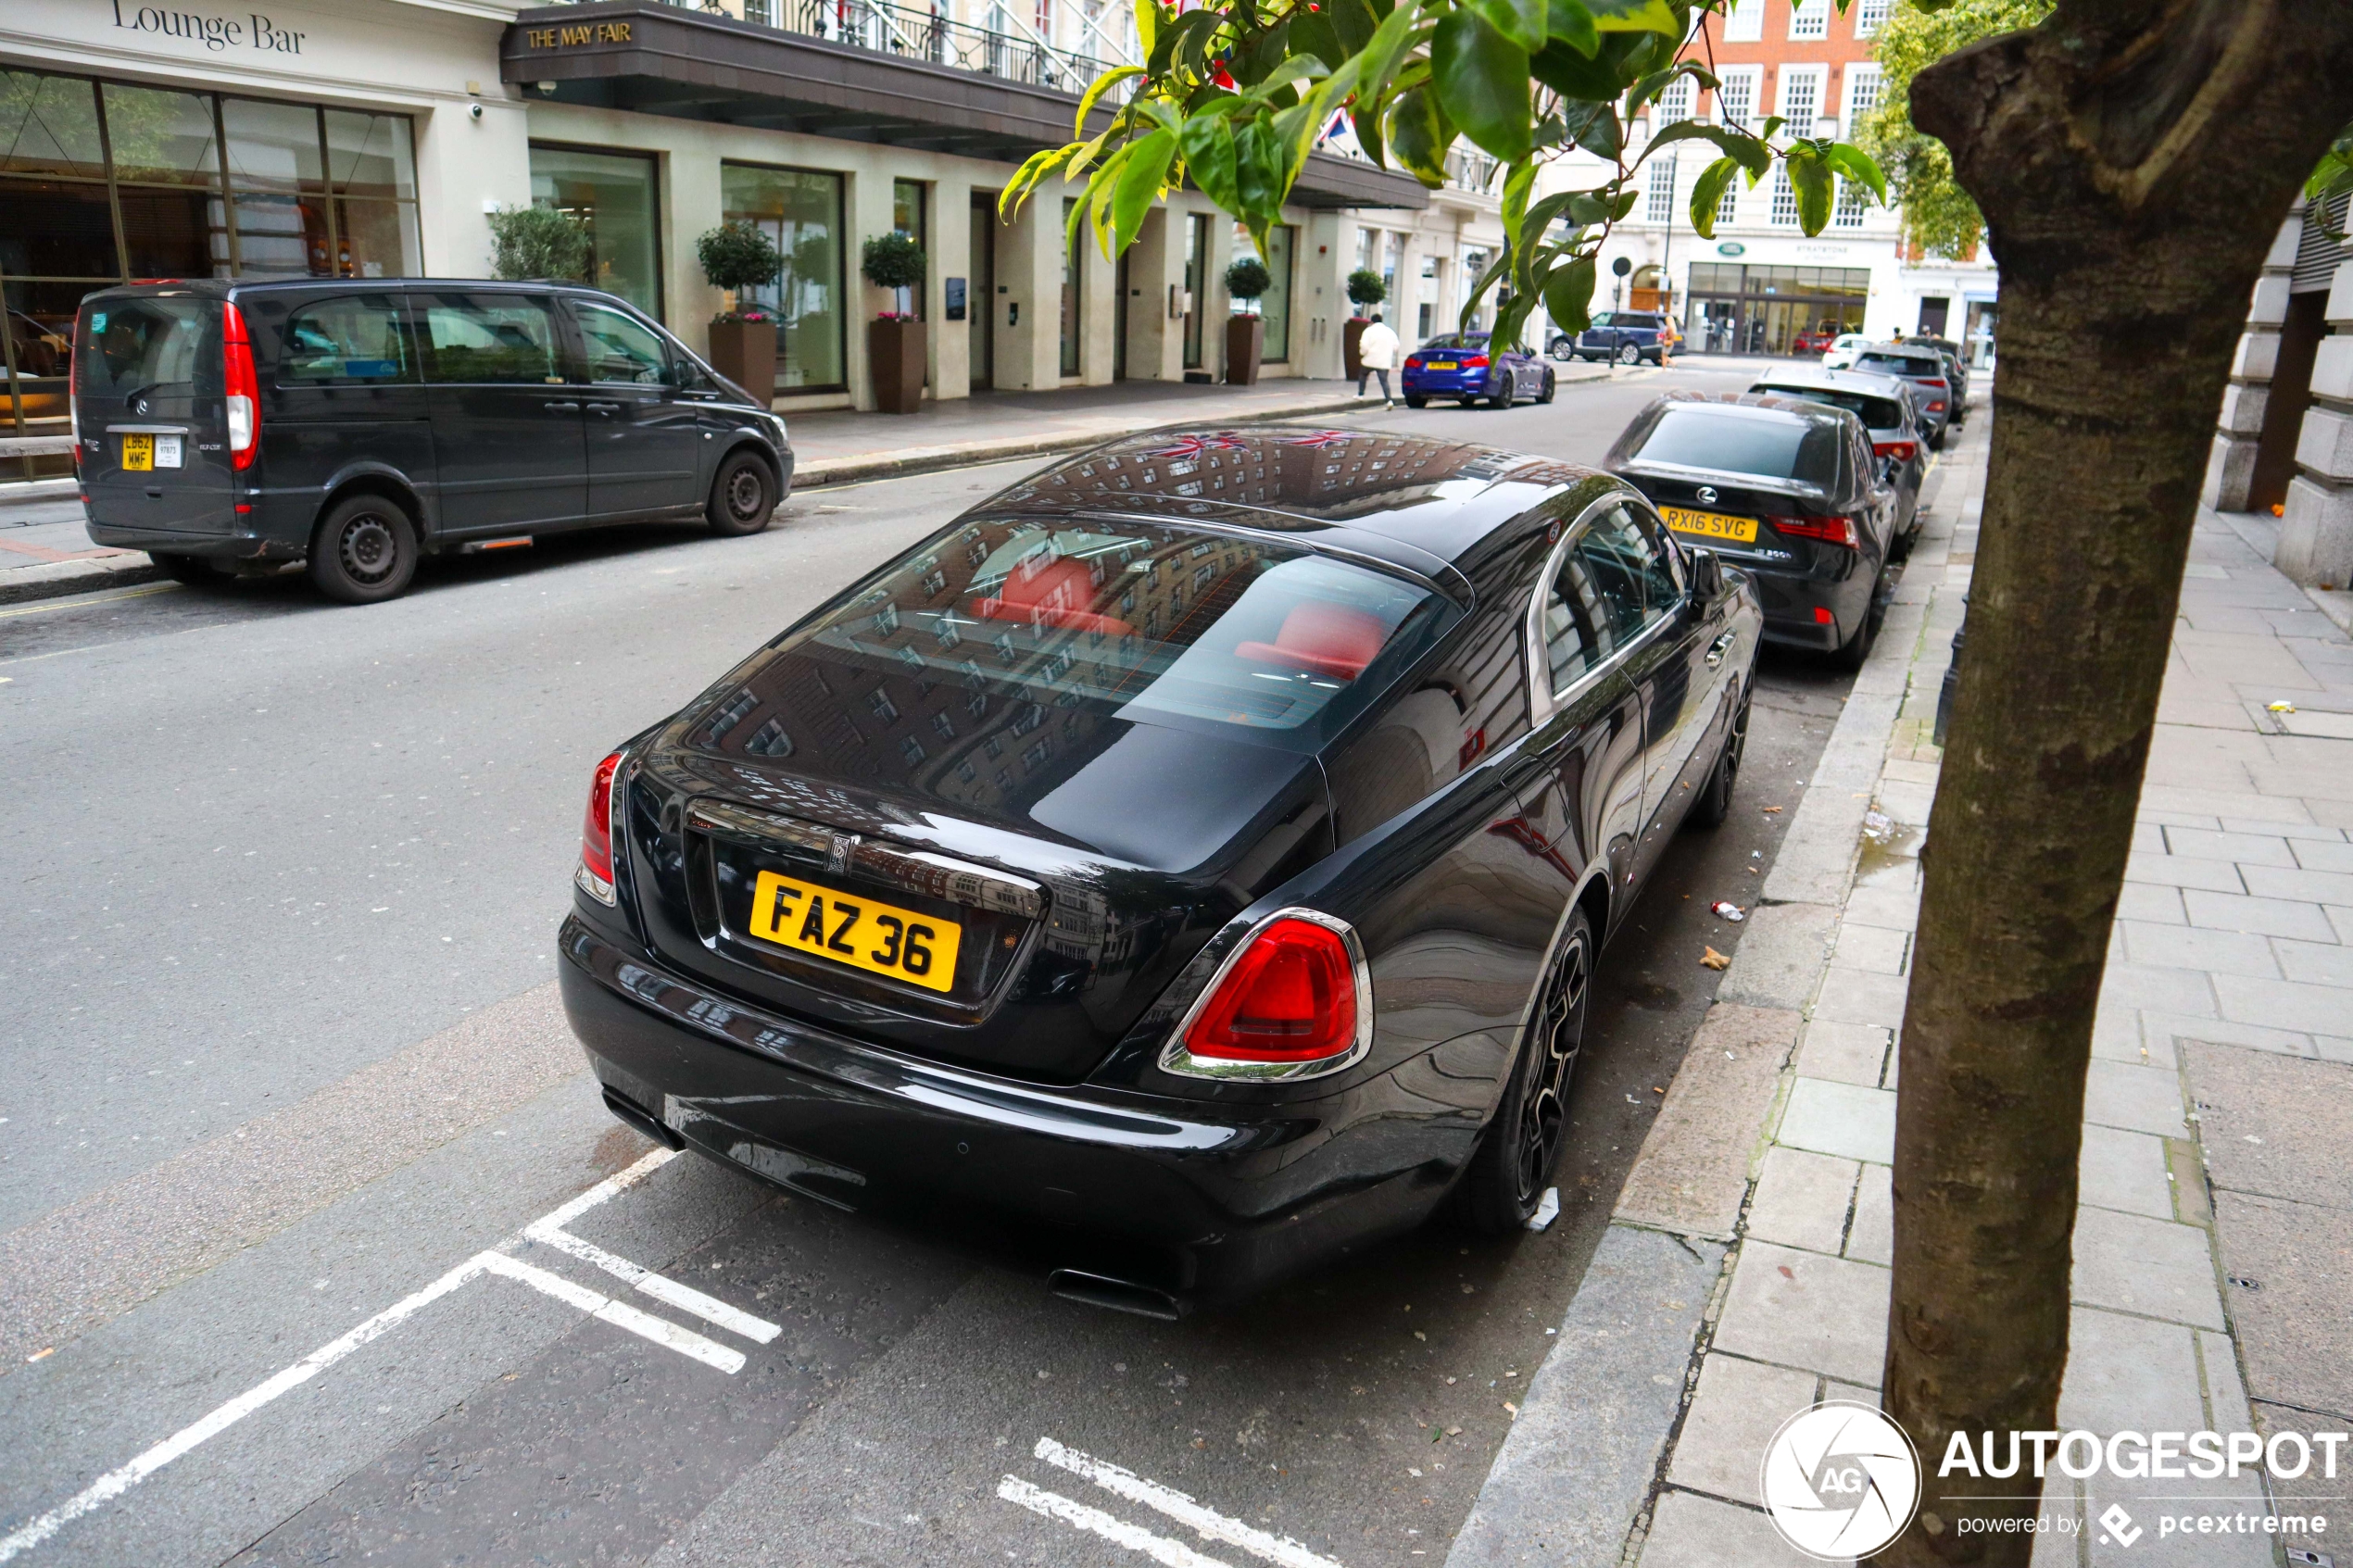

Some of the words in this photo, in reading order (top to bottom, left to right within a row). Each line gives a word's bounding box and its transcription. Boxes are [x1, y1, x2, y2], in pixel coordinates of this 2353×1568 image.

[112, 0, 243, 52] Lounge
[247, 13, 306, 55] Bar
[526, 28, 557, 49] THE
[560, 25, 593, 46] MAY
[598, 22, 632, 44] FAIR
[126, 433, 149, 449] LB62
[128, 451, 146, 466] MMF
[1667, 509, 1707, 531] RX16
[1711, 517, 1746, 537] SVG
[770, 884, 862, 956] FAZ
[871, 914, 936, 975] 36
